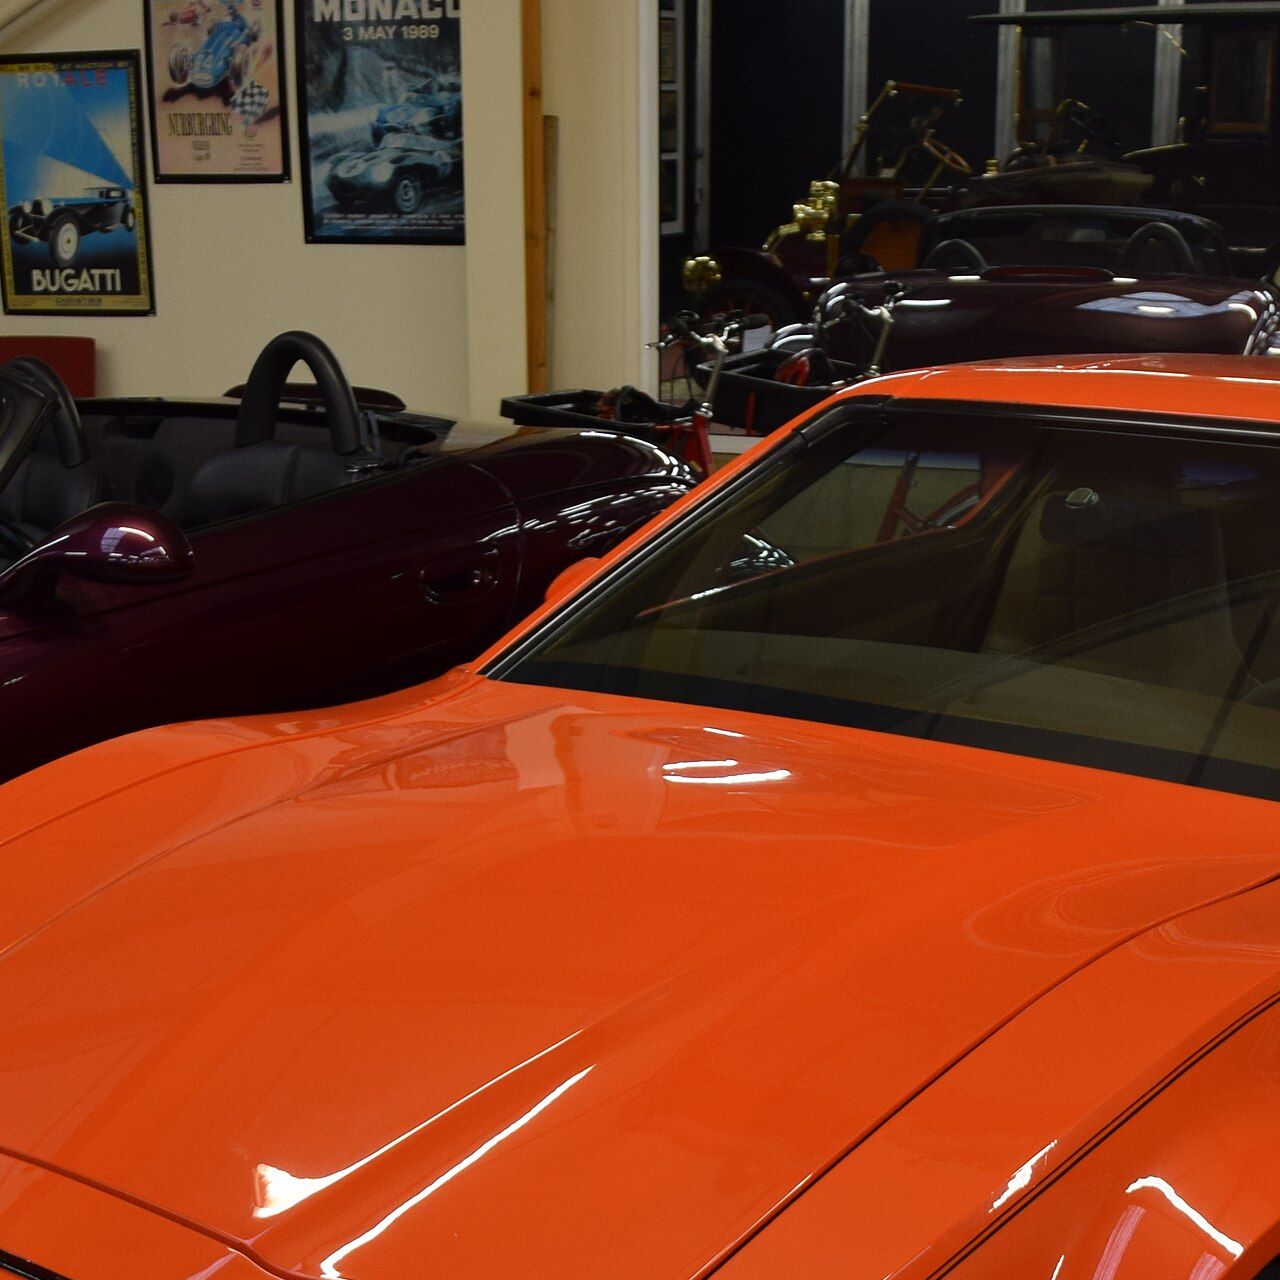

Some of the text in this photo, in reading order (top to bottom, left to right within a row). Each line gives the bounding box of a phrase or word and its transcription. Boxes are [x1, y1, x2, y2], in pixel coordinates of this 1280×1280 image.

[342, 24, 439, 41] 3 MAY 1989
[31, 267, 122, 292] BUGATTI
